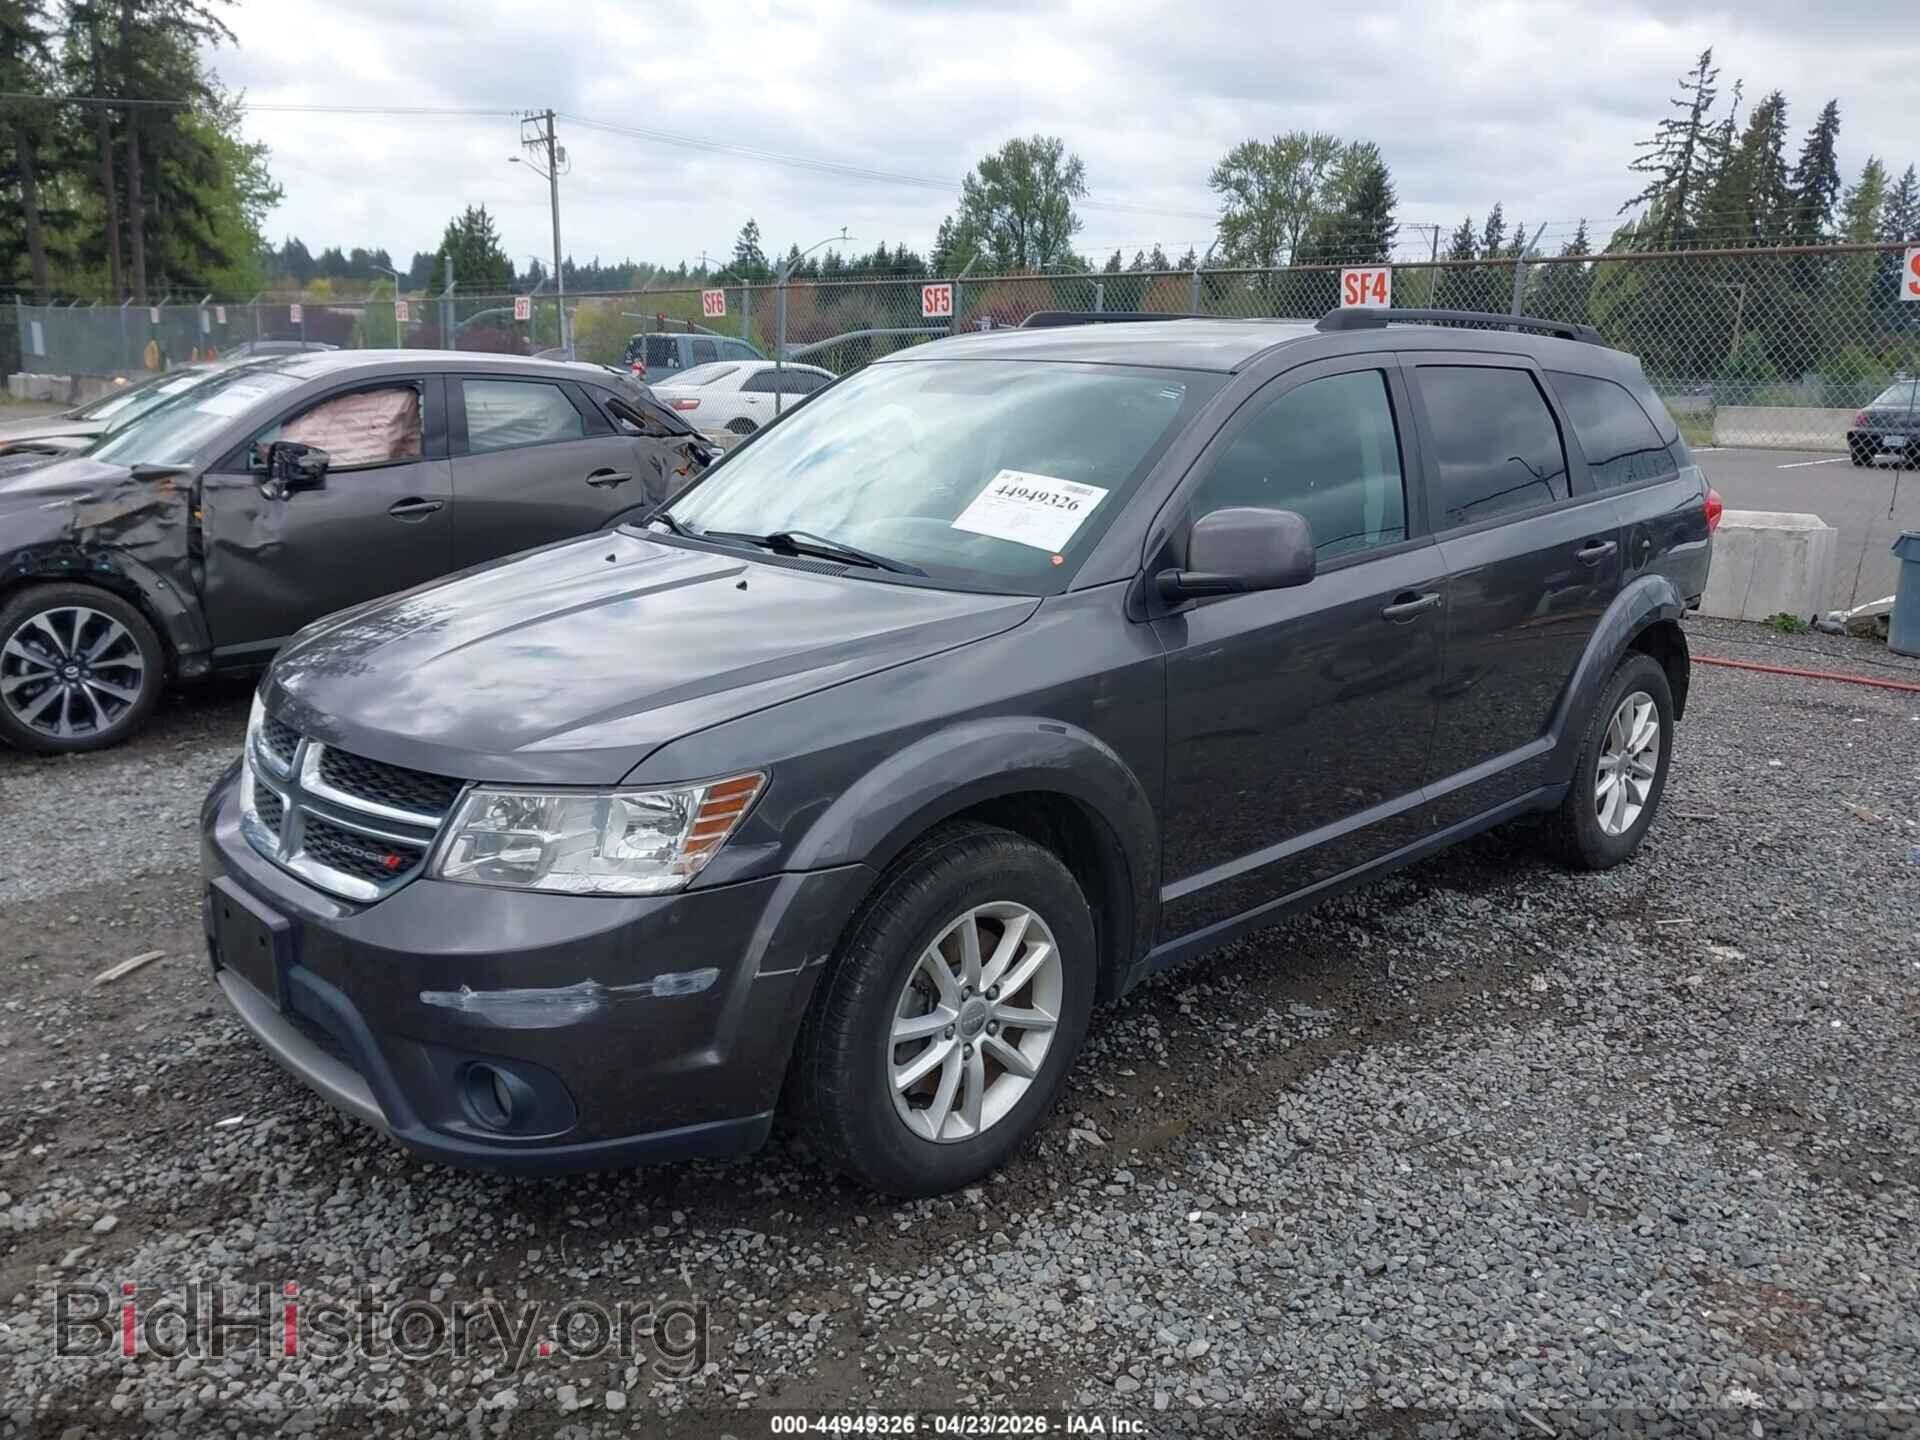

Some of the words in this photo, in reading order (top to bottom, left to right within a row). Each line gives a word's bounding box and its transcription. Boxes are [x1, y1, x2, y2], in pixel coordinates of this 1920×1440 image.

[924, 287, 950, 314] SF5
[1344, 271, 1387, 305] SF4
[704, 292, 724, 314] SF6
[995, 484, 1080, 512] 44949326
[330, 840, 388, 865] DODGE
